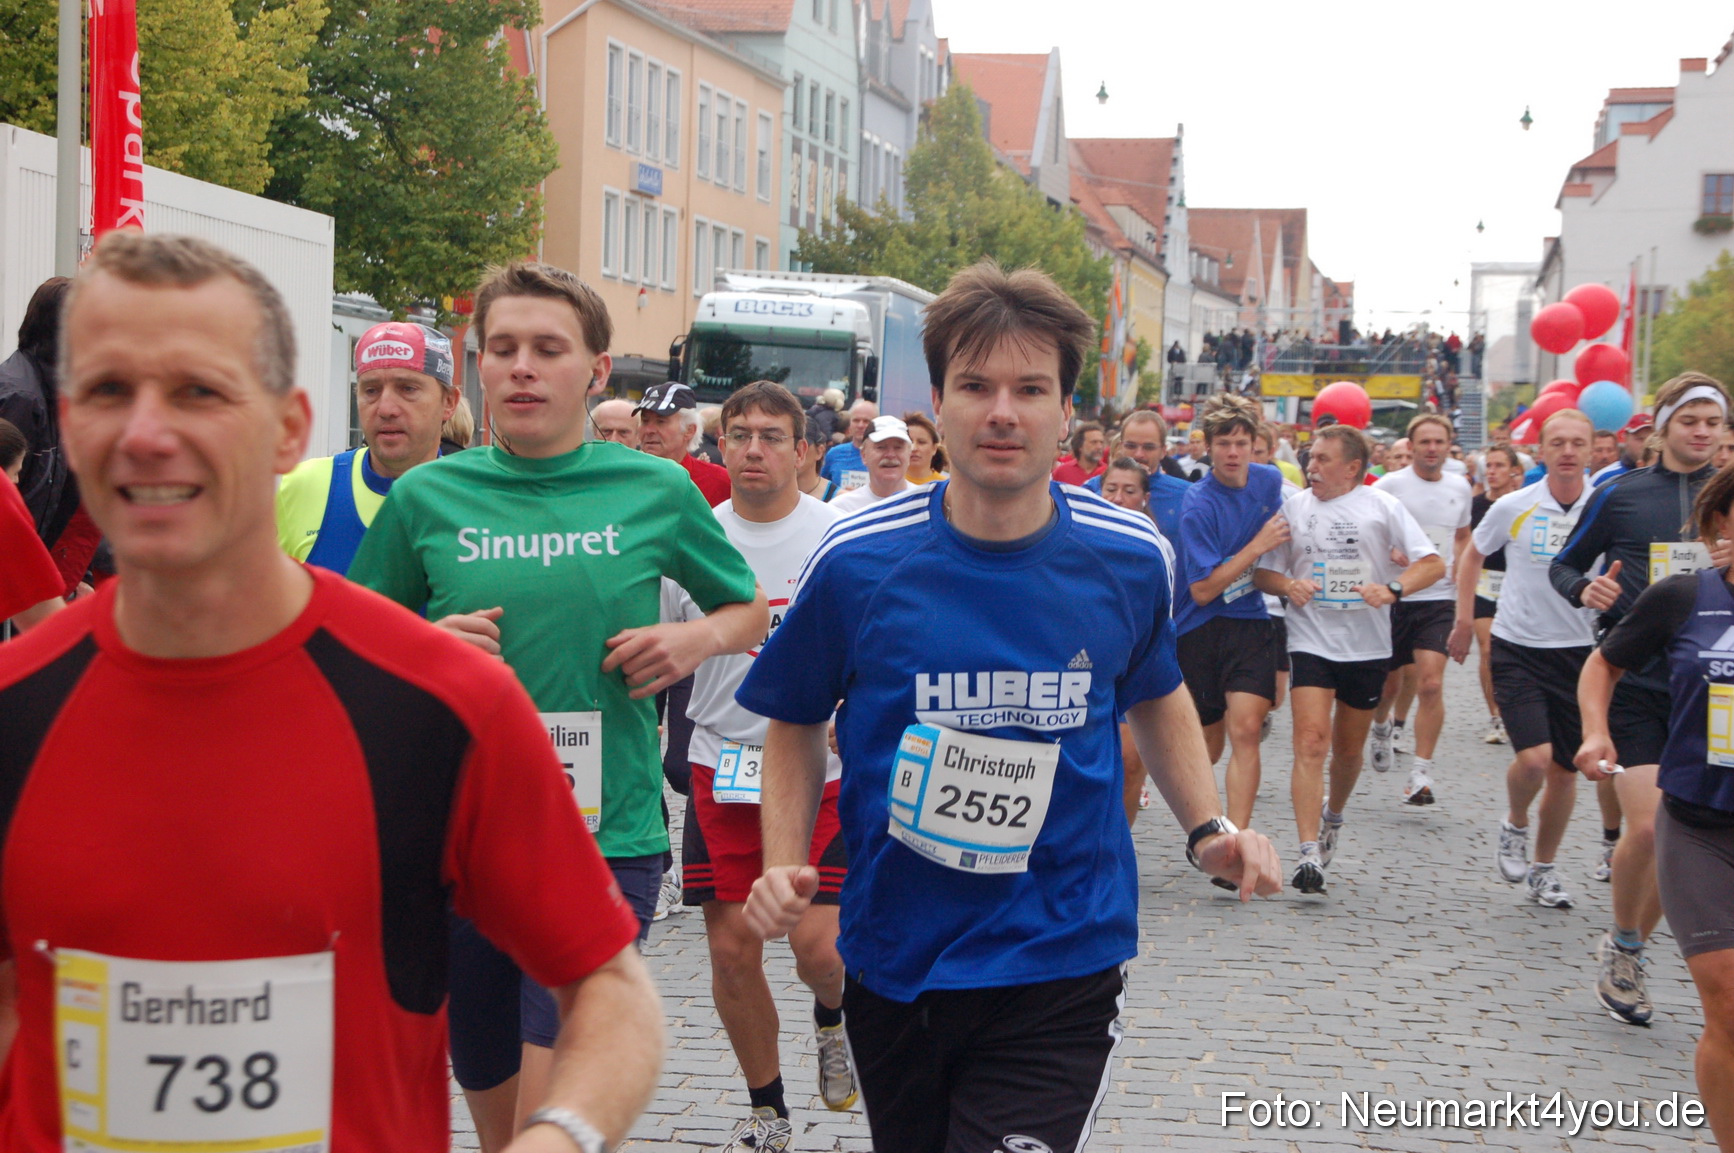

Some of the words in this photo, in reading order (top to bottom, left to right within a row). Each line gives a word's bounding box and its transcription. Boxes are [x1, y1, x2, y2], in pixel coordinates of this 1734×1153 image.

[735, 299, 814, 317] BOCK
[458, 524, 620, 567] Sinupret
[1671, 549, 1698, 563] Andy
[1067, 660, 1093, 670] adidas
[915, 671, 1092, 711] HUBER
[955, 711, 1081, 727] TECHNOLOGY
[901, 770, 913, 788] B
[943, 744, 1035, 784] Christoph
[934, 784, 1032, 829] 2552
[120, 980, 272, 1025] Gerhard
[67, 1038, 81, 1069] C
[147, 1052, 280, 1114] 738
